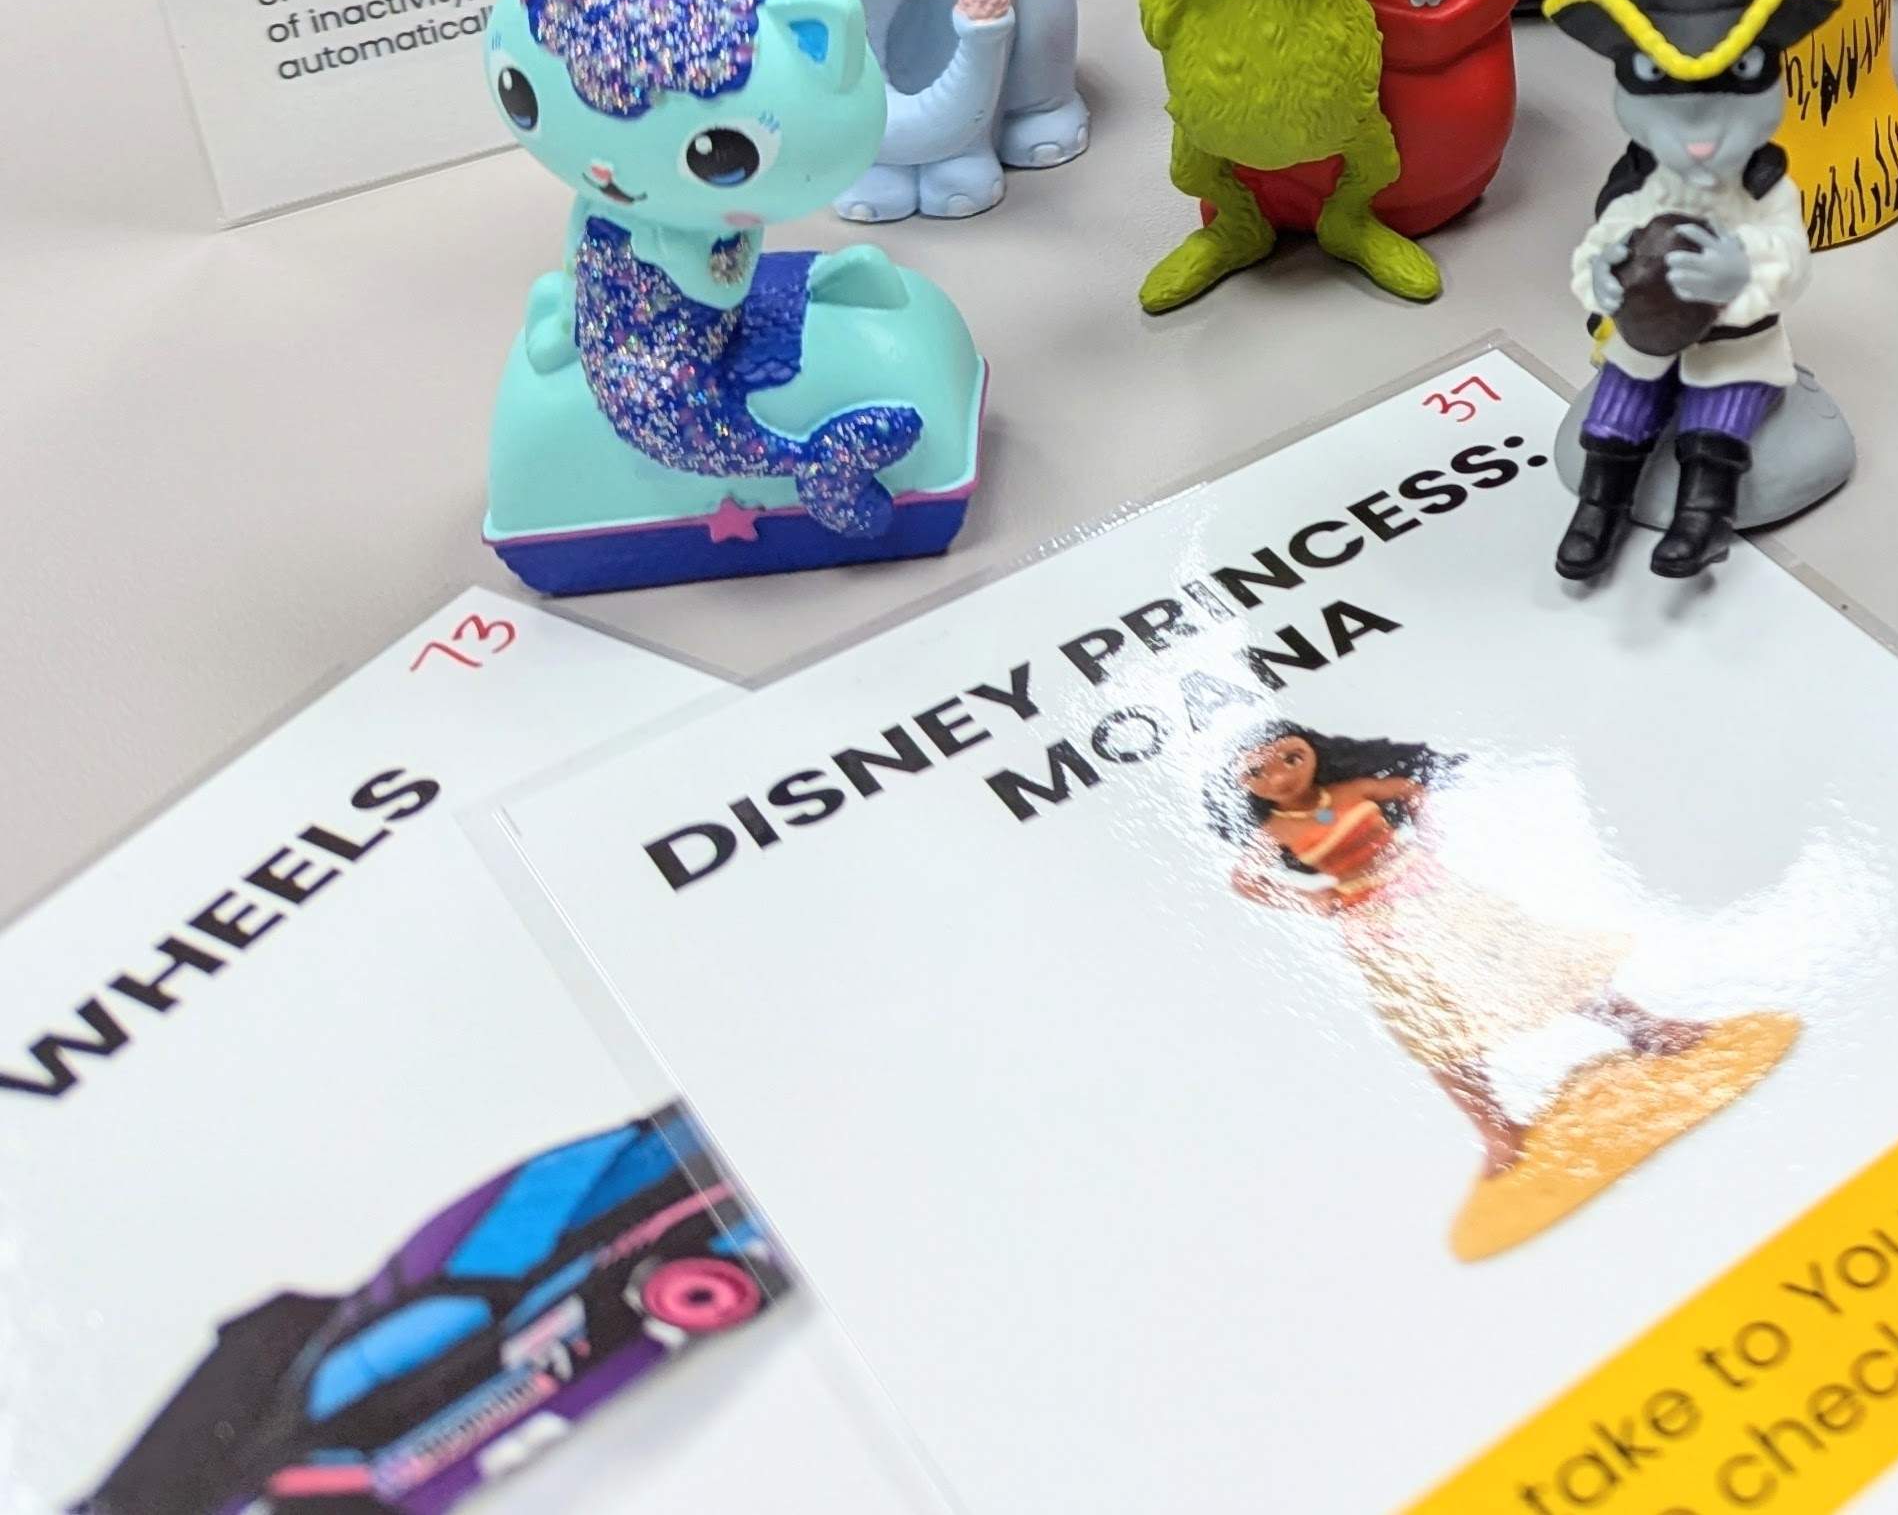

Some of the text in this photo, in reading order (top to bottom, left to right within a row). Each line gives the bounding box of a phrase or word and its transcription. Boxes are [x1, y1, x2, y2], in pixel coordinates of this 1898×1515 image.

[267, 13, 300, 43] of
[1422, 376, 1502, 423] 37
[409, 614, 516, 671] 73
[643, 436, 1548, 892] DISNEY PRINCESS:
[983, 599, 1404, 823] MOANA
[0, 767, 441, 1097] WHEELS
[1517, 1388, 1702, 1515] take
[1695, 1319, 1791, 1391] to
